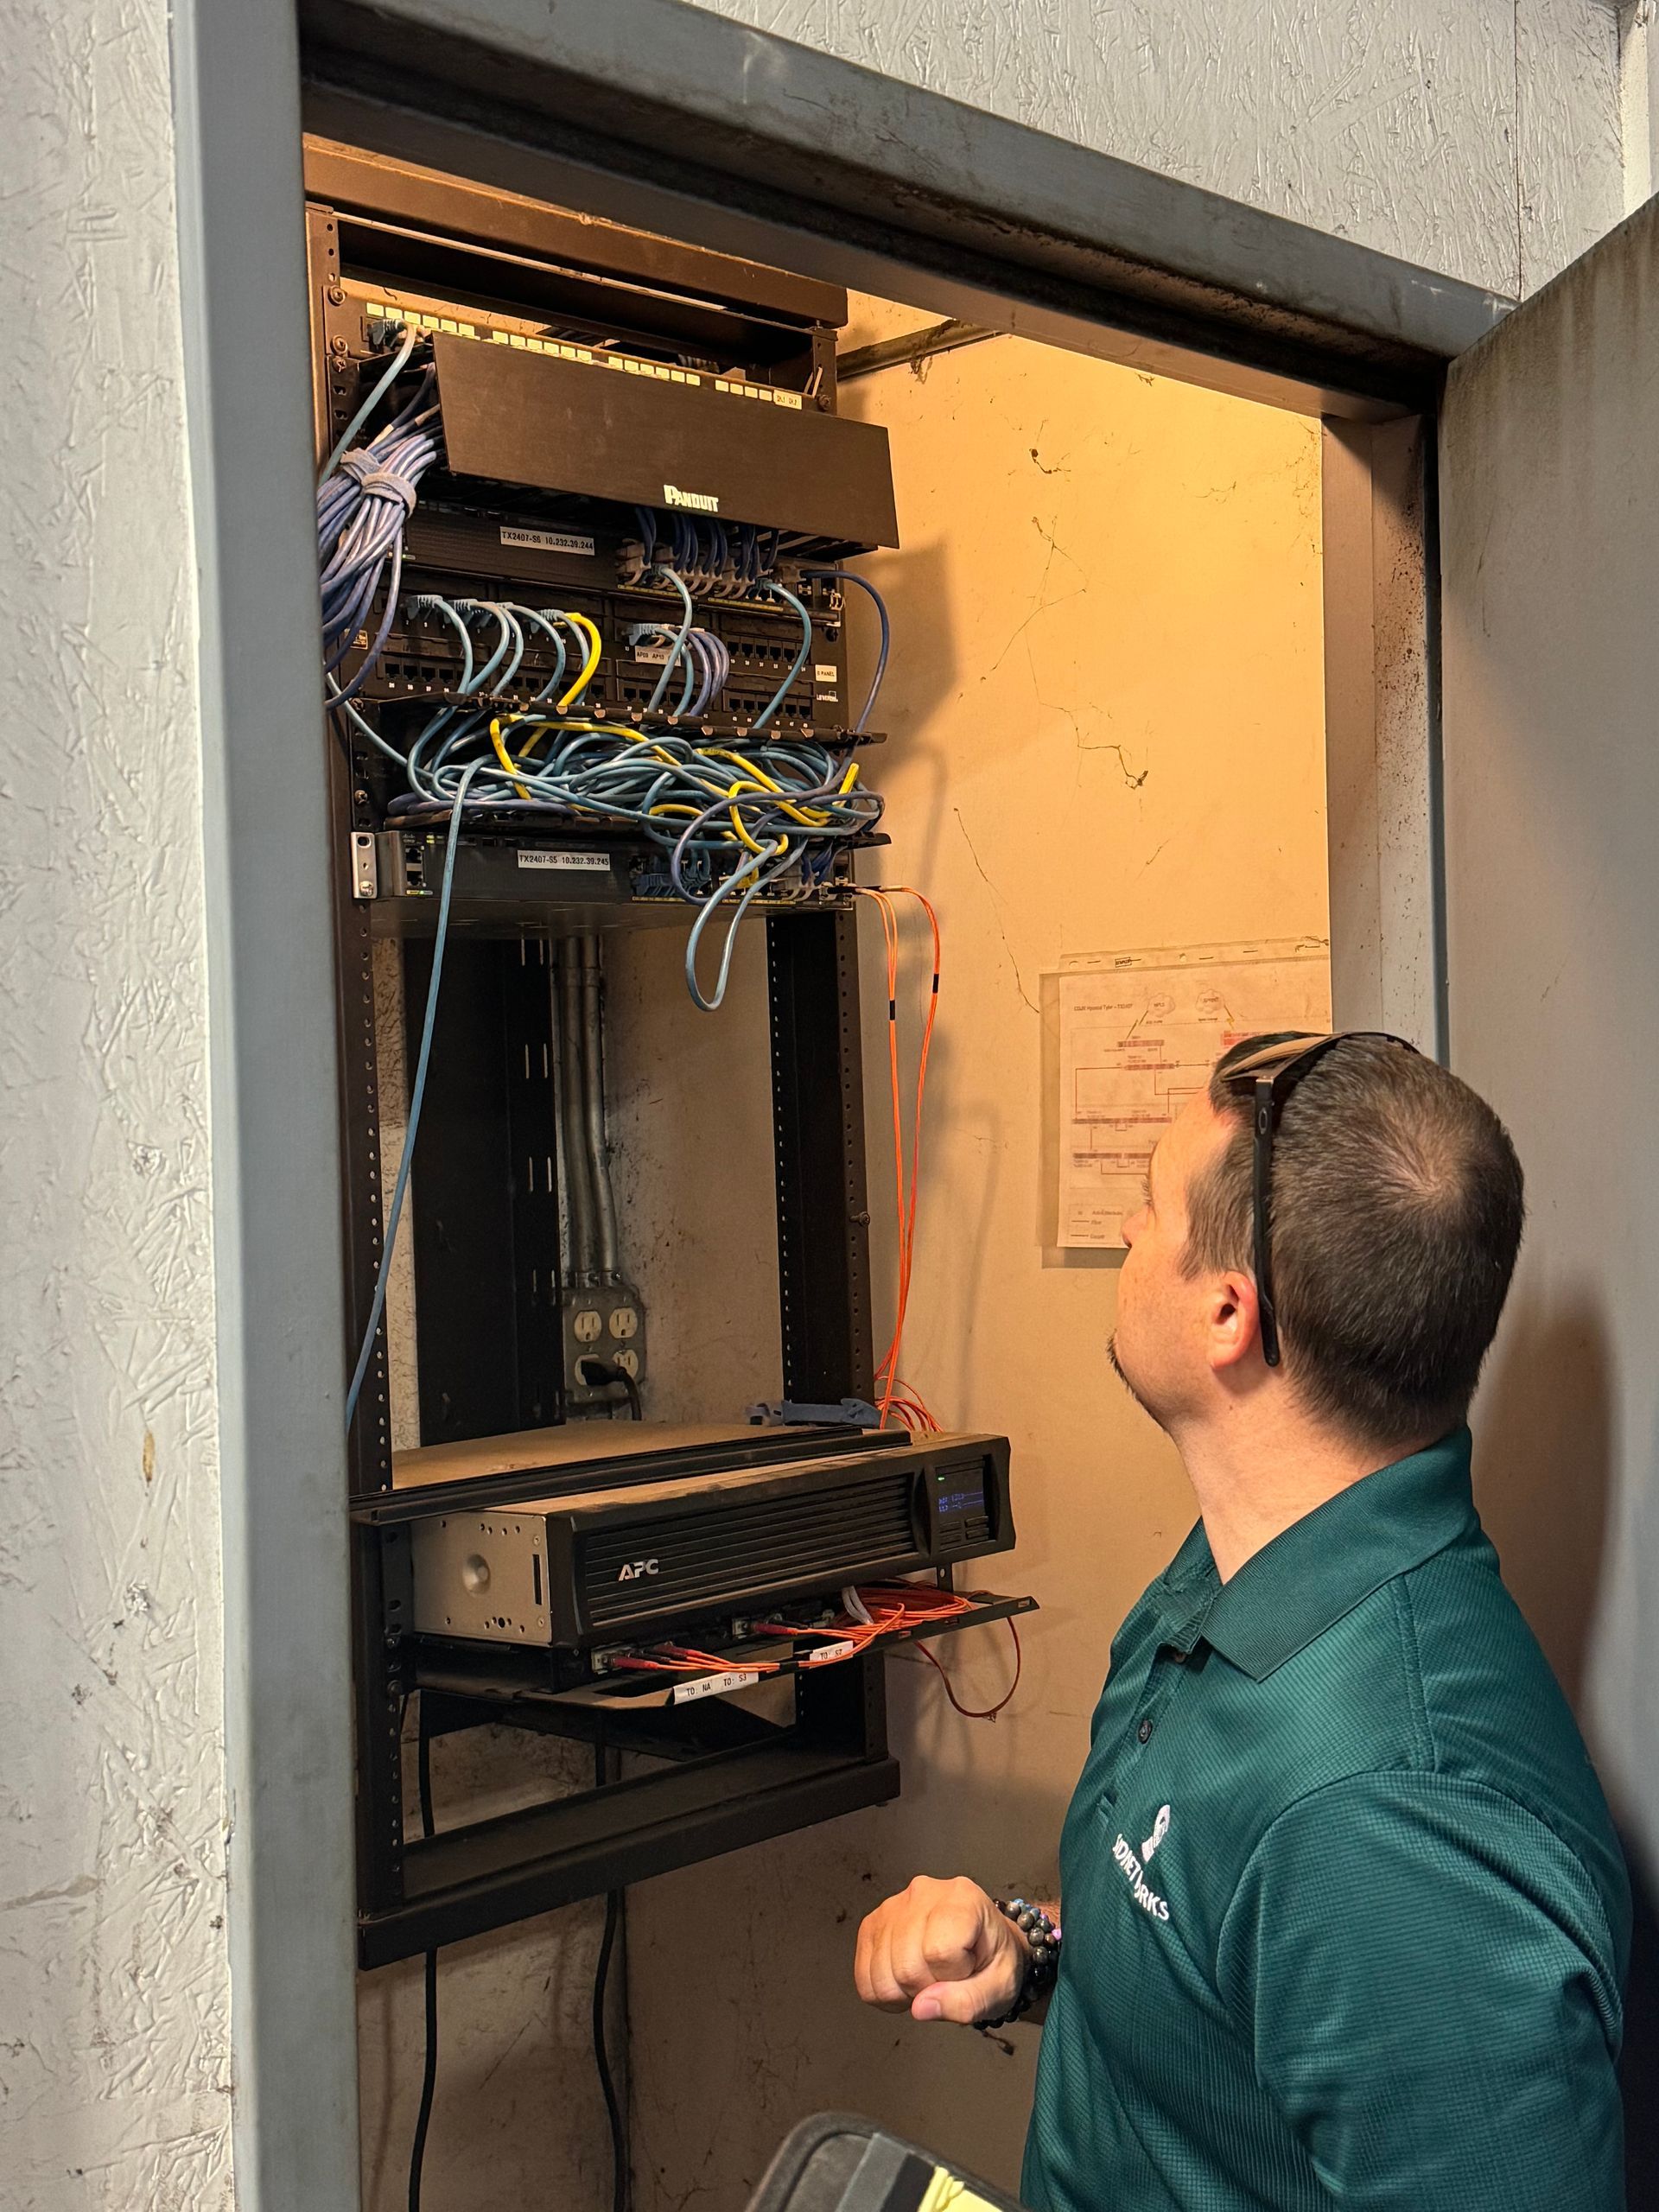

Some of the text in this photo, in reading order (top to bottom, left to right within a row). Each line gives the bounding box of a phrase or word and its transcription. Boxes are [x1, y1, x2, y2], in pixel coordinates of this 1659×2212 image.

[664, 484, 719, 512] PANDUIT
[545, 537, 594, 550] 10.232.39.244
[519, 855, 609, 866] TX2407-S5 10.232.39.245
[619, 1559, 659, 1581] APC
[702, 1682, 711, 1693] NA
[739, 1673, 747, 1682] S3
